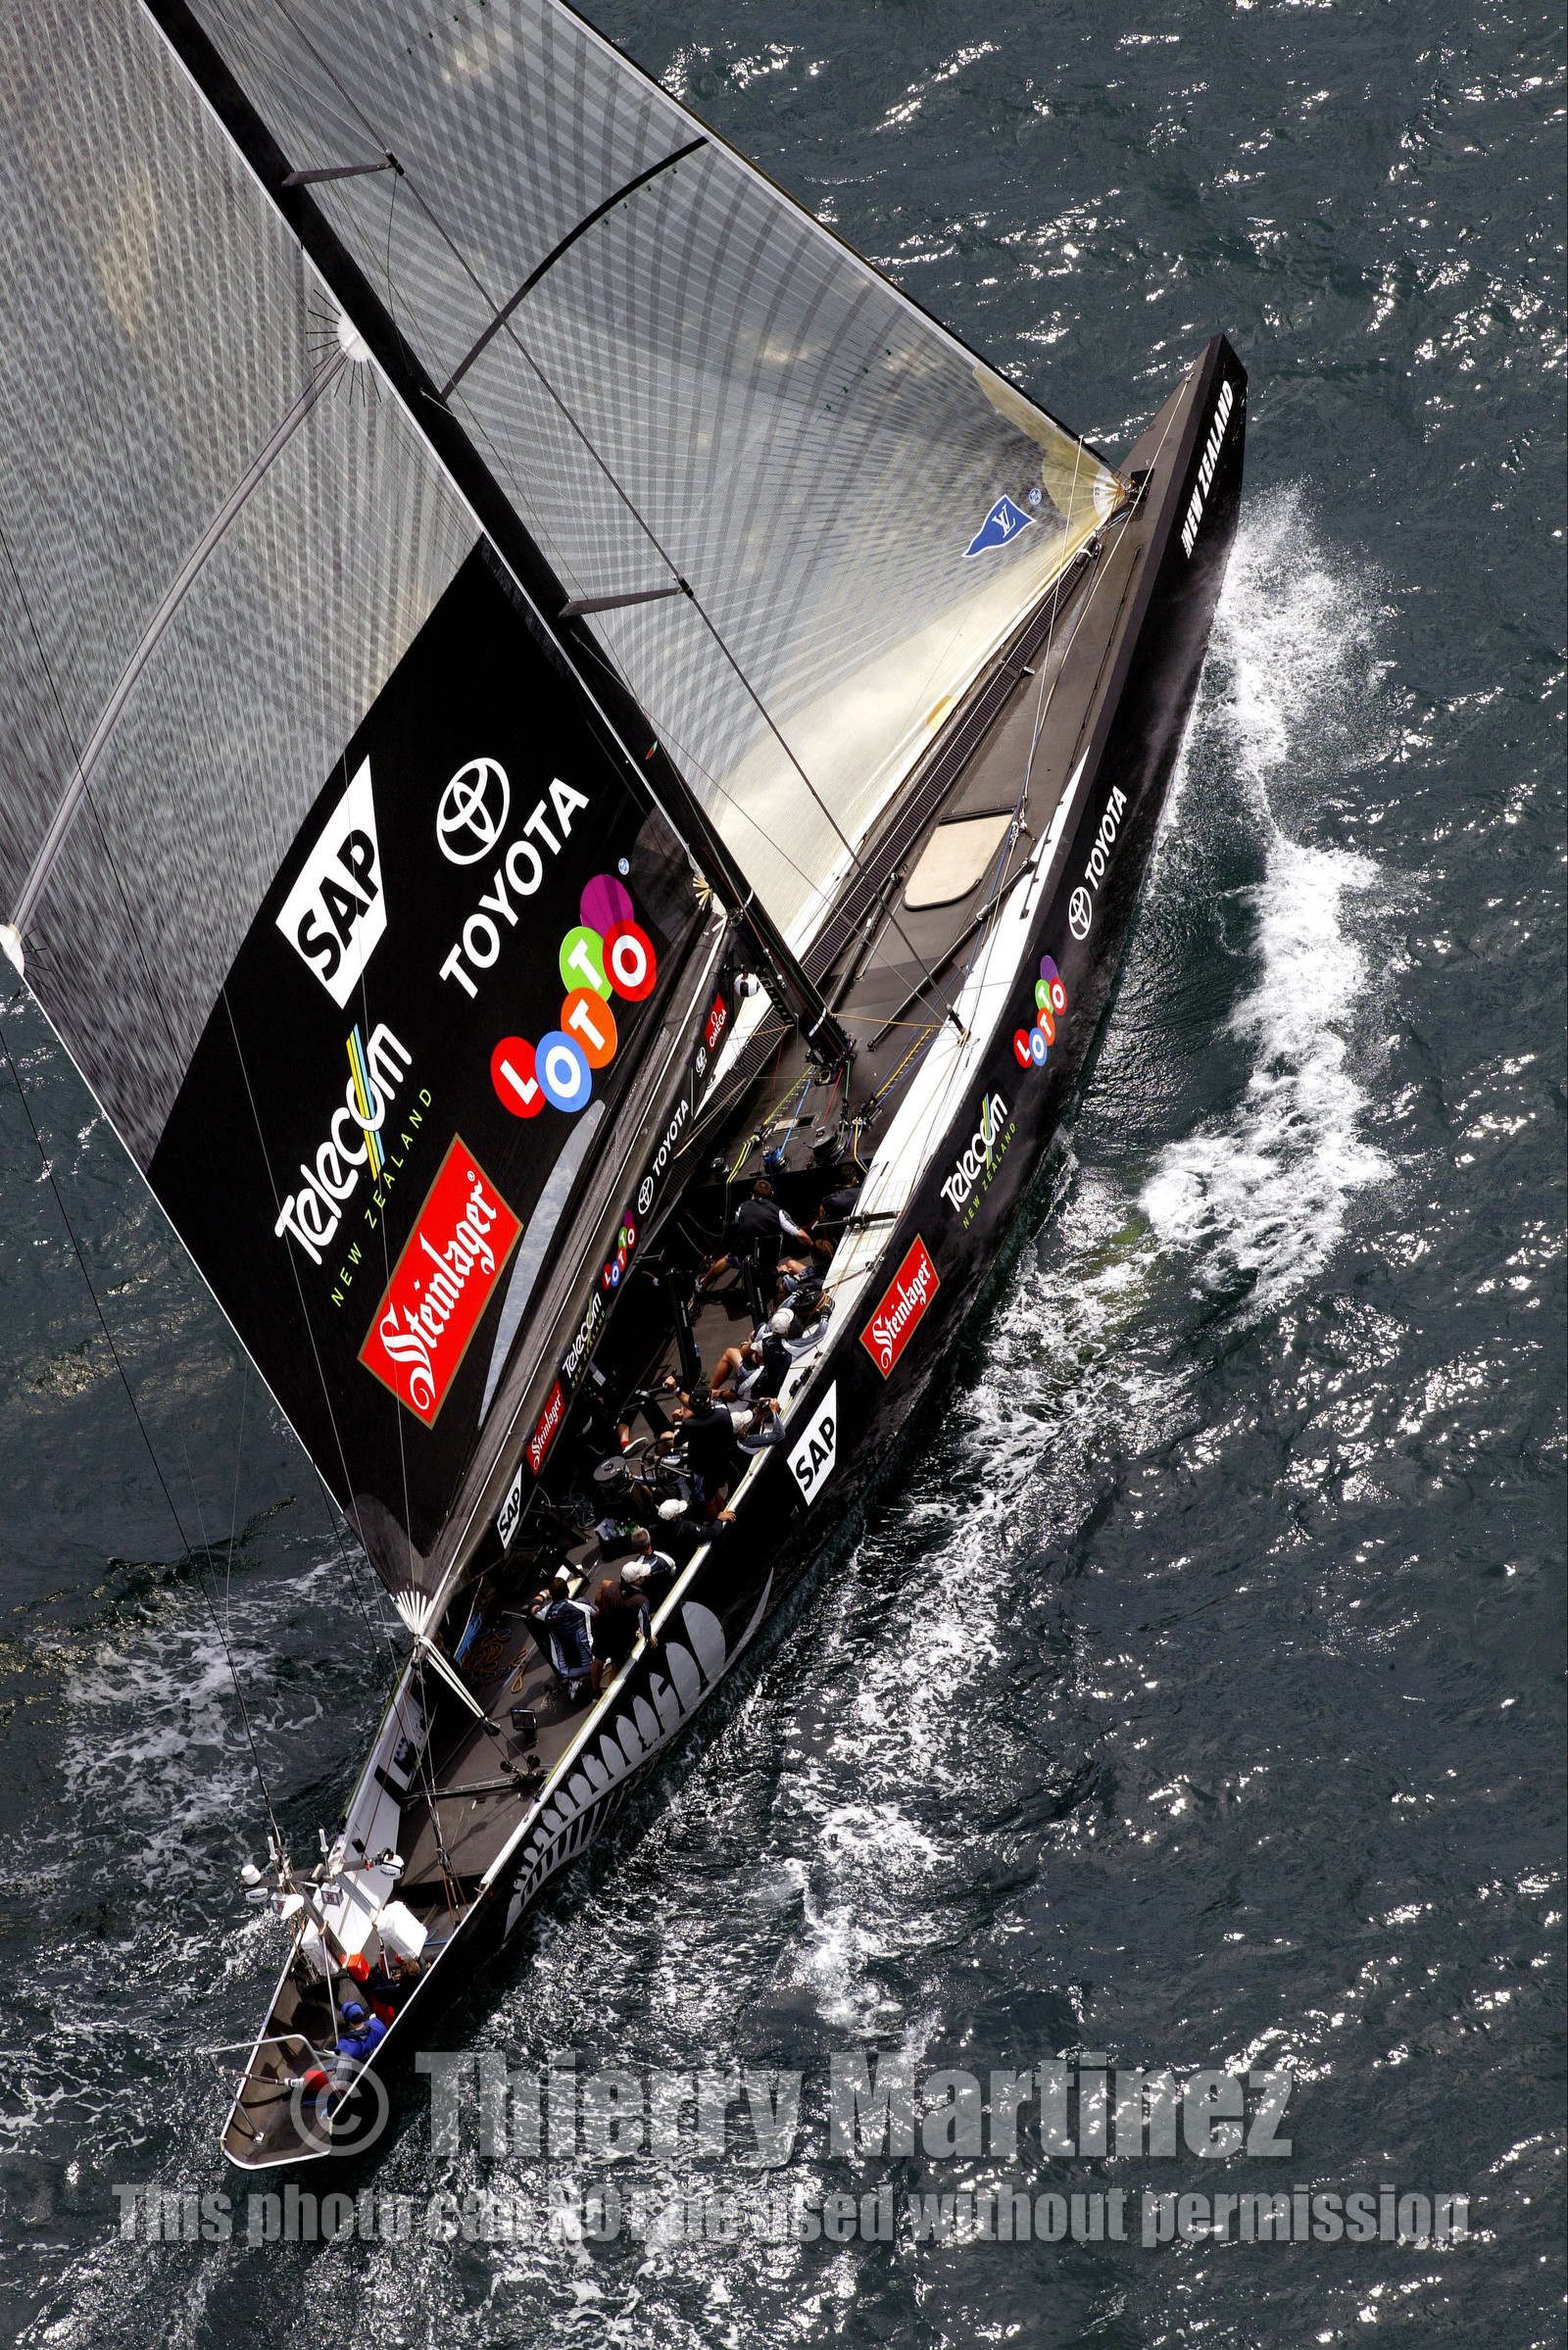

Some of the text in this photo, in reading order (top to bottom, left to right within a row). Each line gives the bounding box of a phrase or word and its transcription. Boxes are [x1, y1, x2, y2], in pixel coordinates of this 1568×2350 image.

[1181, 380, 1233, 560] NEW ZEALAND
[439, 777, 590, 999] TOYOTA
[1085, 785, 1127, 891] TOYOTA
[297, 829, 379, 982] SAP
[500, 934, 647, 1105] LOTTO
[709, 1008, 727, 1048] OMEGA
[1016, 984, 1064, 1061] LOTTO
[274, 1023, 413, 1265] Telecom
[653, 1100, 689, 1176] TOYOTA
[940, 1093, 1008, 1213] Telecom
[962, 1120, 1016, 1229] NEW ZEALAND
[331, 1089, 432, 1307] NEW ZEALAND
[604, 1228, 635, 1285] LOTTO
[563, 1293, 602, 1379] Telecom
[872, 1258, 931, 1369] Steinlager
[531, 1392, 563, 1471] Steinlager
[796, 1416, 835, 1492] SAP
[499, 1487, 521, 1541] SAP
